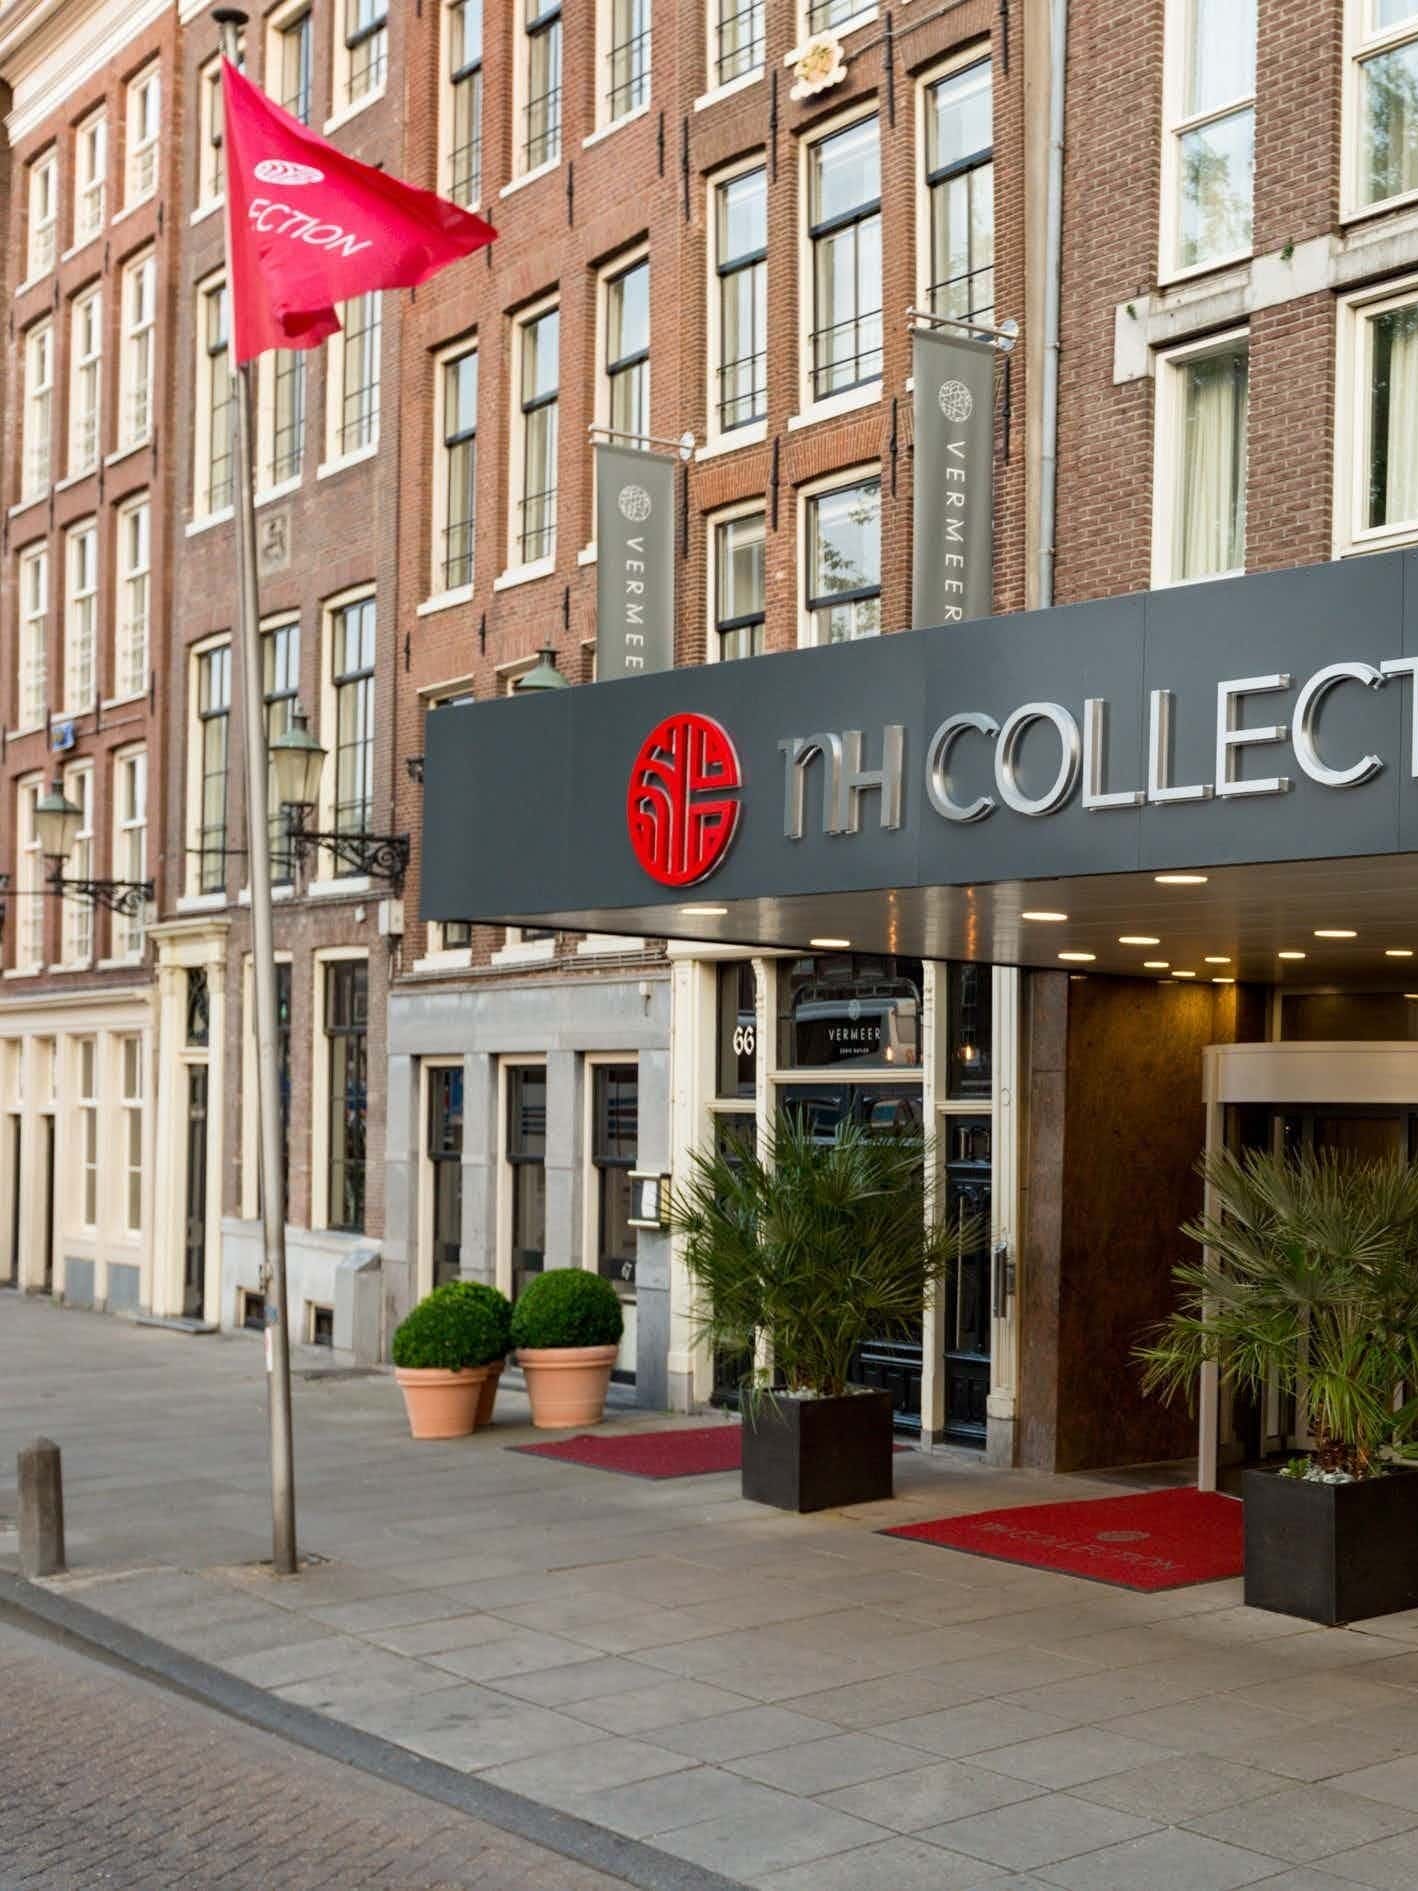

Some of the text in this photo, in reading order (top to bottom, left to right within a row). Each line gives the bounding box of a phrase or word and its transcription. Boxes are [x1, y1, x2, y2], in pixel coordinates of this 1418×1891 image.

[944, 440, 966, 621] VERMEER
[625, 537, 645, 669] VERMEE
[733, 1026, 755, 1055] 66
[828, 1027, 881, 1041] VERMEER
